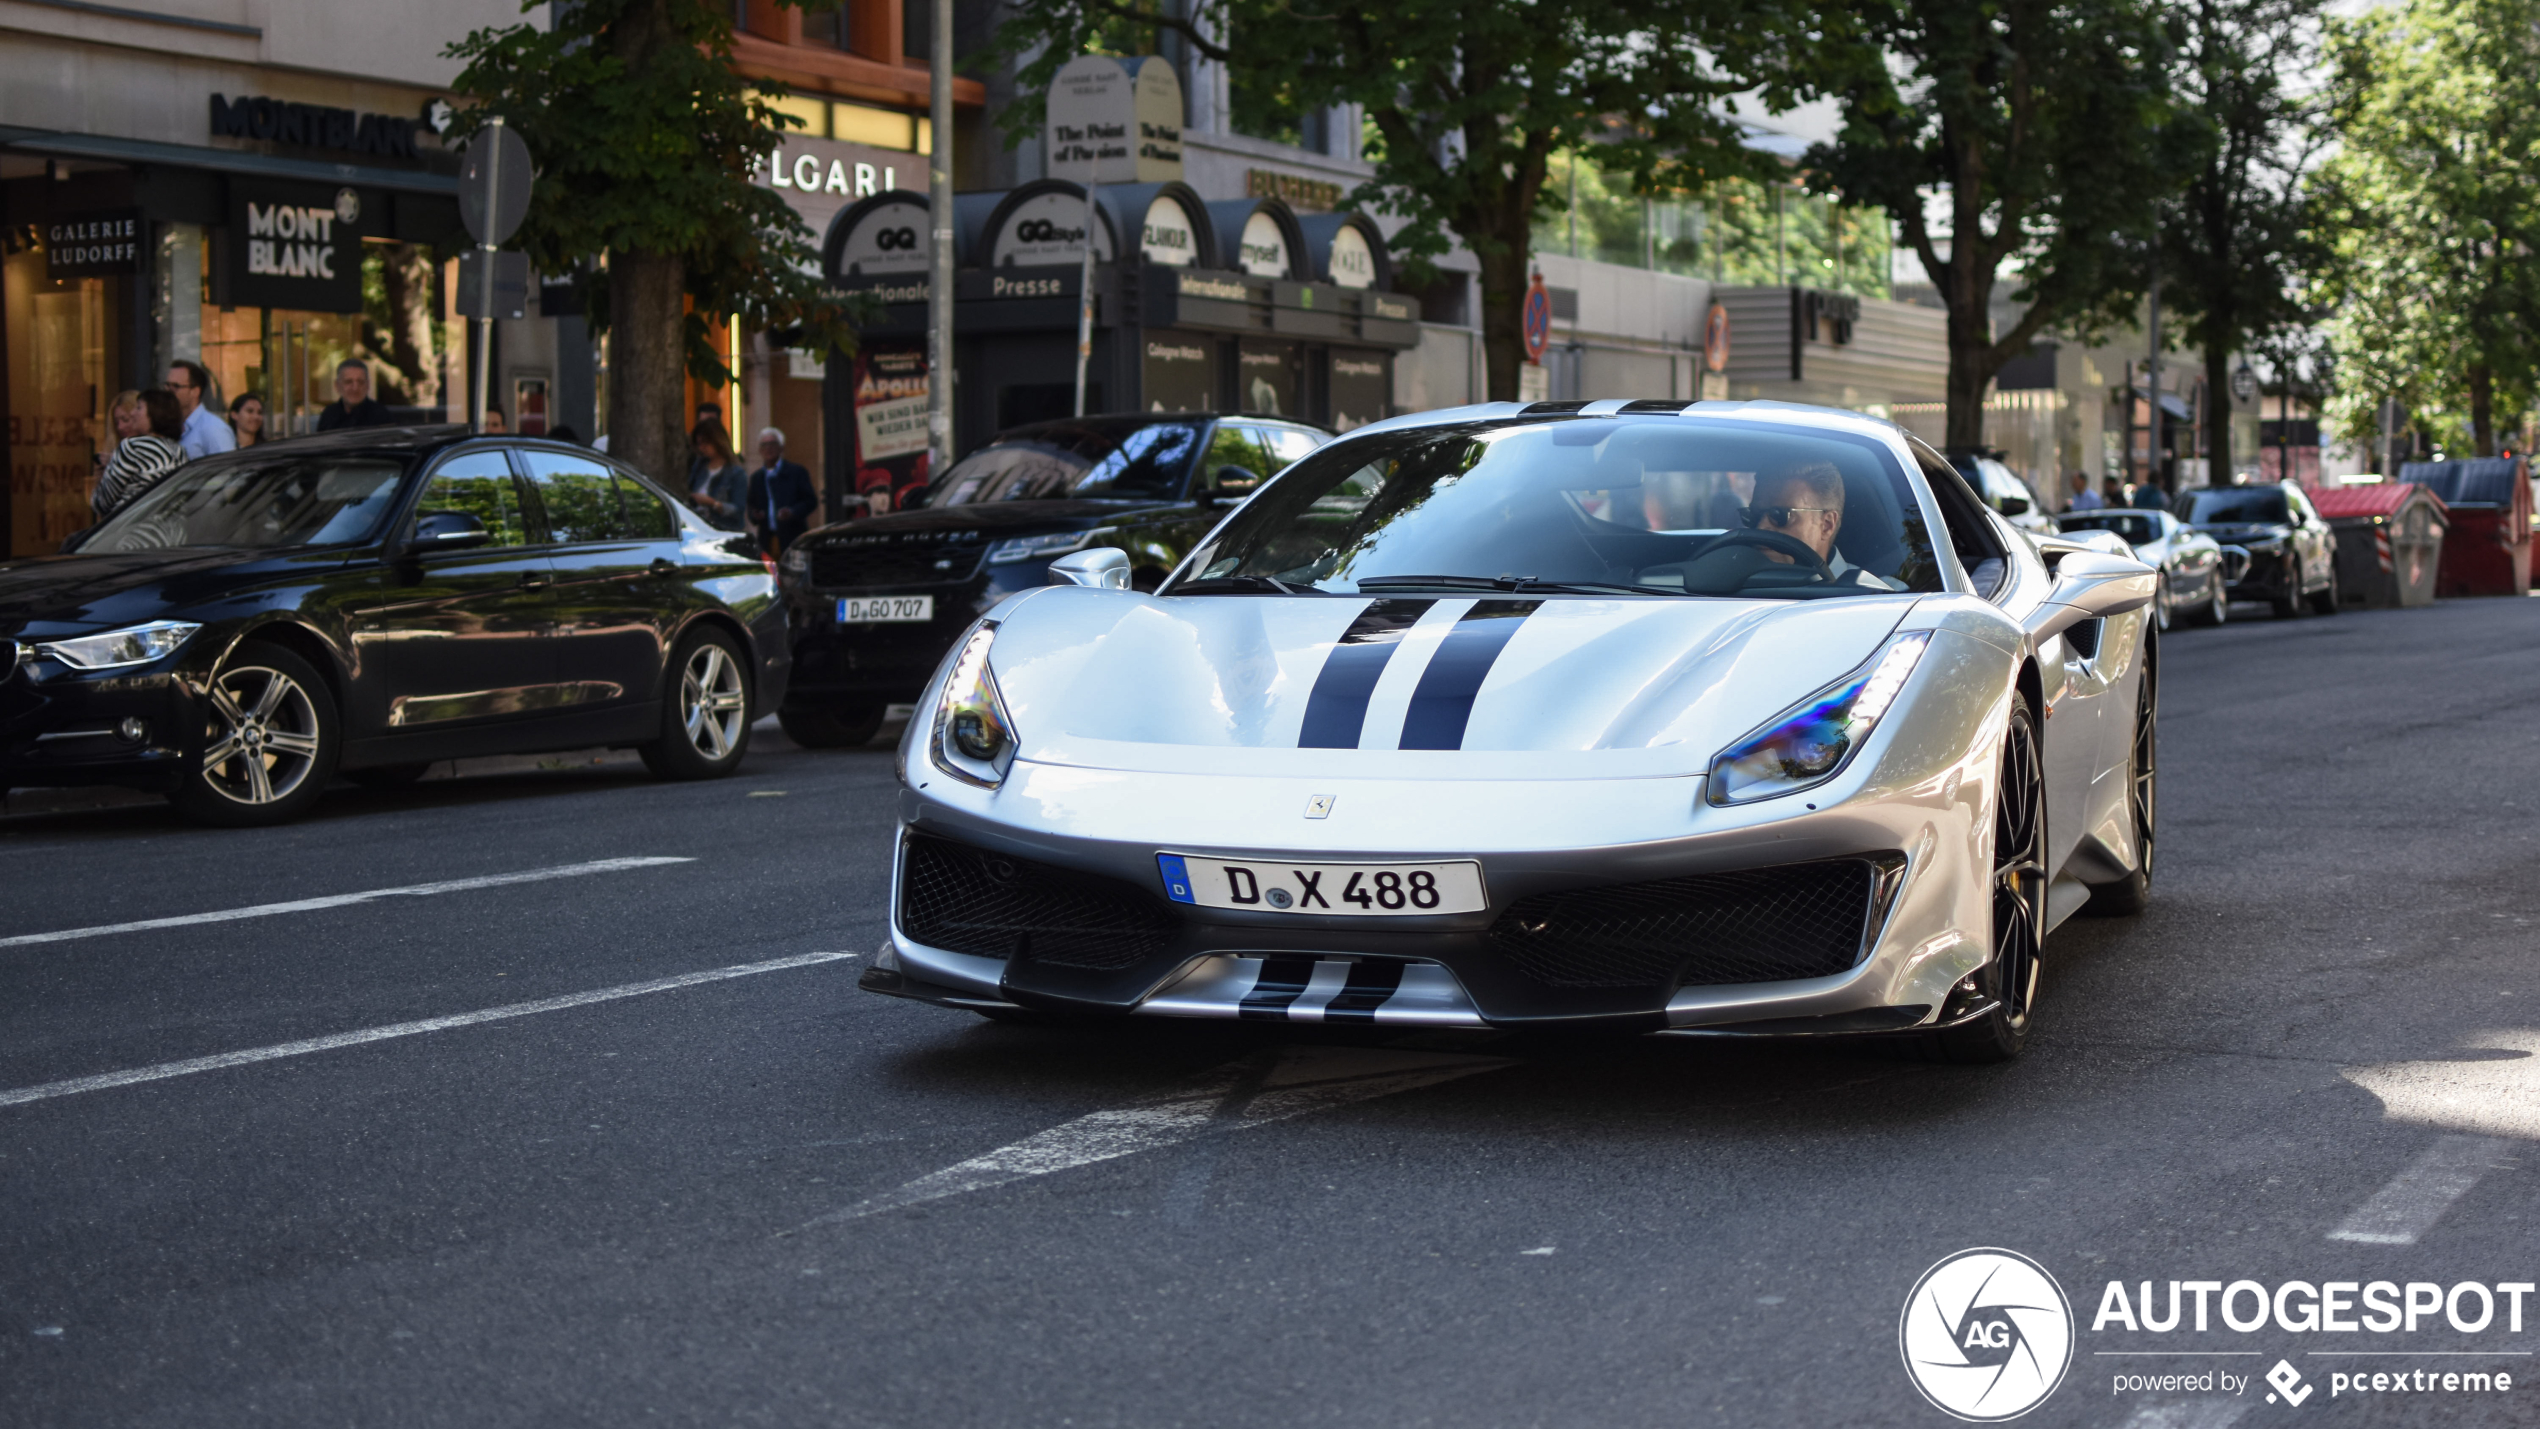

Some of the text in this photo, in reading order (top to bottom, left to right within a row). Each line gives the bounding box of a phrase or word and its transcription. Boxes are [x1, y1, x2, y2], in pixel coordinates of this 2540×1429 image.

[210, 93, 424, 156] MONTBLANC
[1055, 122, 1125, 142] The Point
[1054, 145, 1069, 162] of
[51, 219, 136, 242] GALERIE
[249, 202, 334, 242] MONT
[876, 227, 917, 251] GQ
[1144, 223, 1187, 250] GLAMOUR
[51, 243, 136, 265] LUDORFF
[249, 240, 335, 279] BLANC
[1240, 242, 1279, 265] myself
[994, 276, 1061, 296] Presse
[825, 530, 980, 546] RANGE ROVER
[850, 601, 860, 619] D
[869, 600, 890, 618] GO
[893, 599, 923, 617] 707
[1172, 884, 1186, 896] D
[1223, 866, 1440, 909] D X 488
